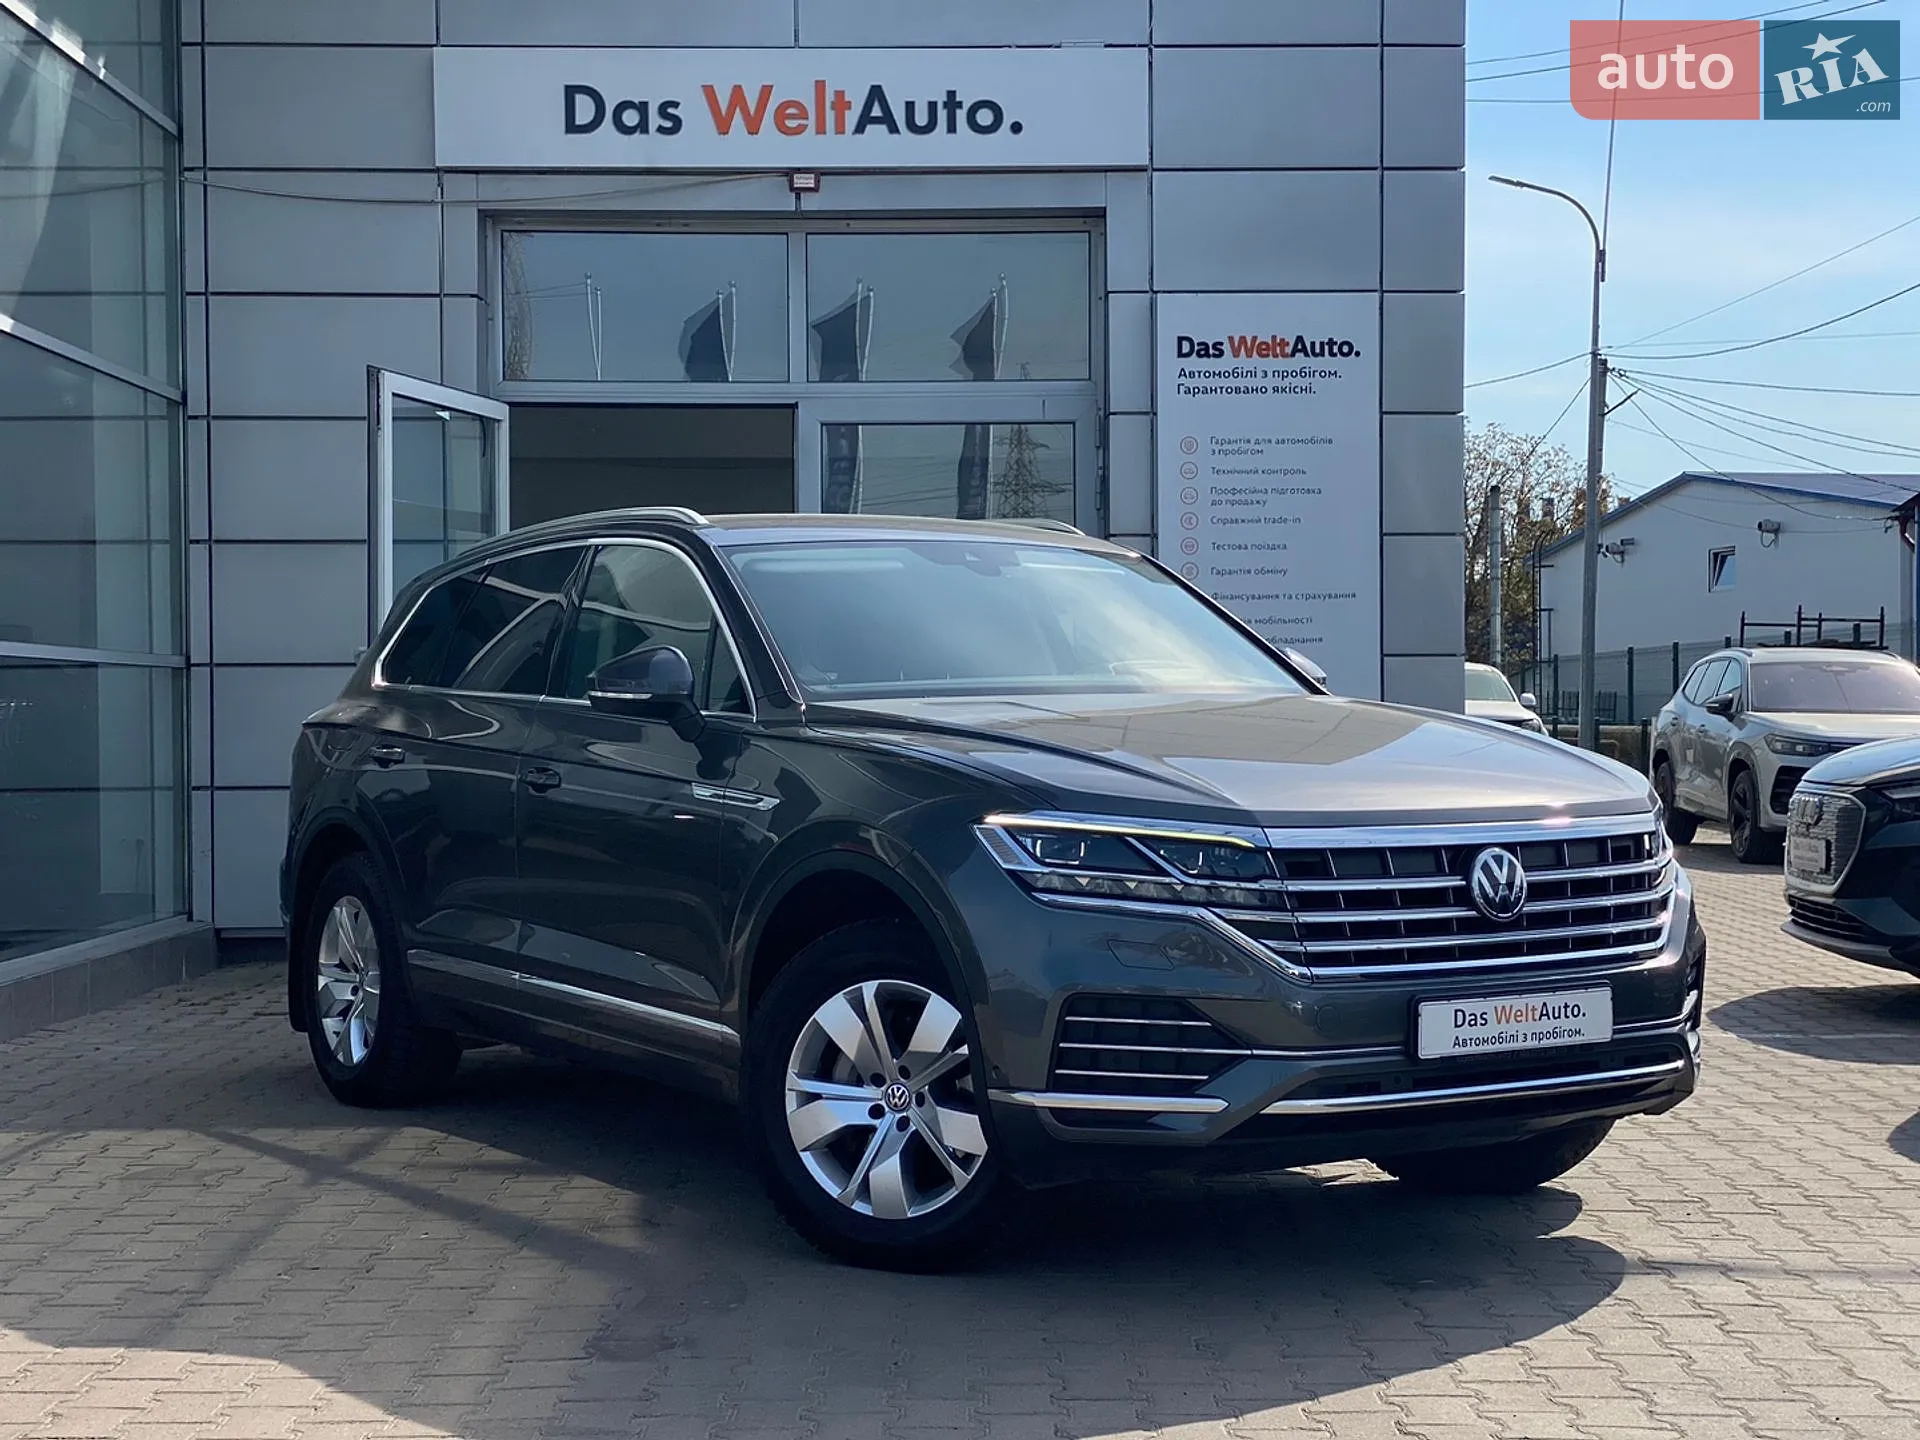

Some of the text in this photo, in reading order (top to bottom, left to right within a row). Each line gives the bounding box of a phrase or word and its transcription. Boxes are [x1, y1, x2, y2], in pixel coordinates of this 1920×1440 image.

[564, 79, 1024, 136] Das WeltAuto.
[1177, 335, 1361, 359] Das WeltAuto.
[1178, 366, 1342, 381] Автомобілі з пробігом.
[1177, 382, 1316, 397] Гарантовано якісні.
[1210, 436, 1333, 447] Гарантія для автомобілів
[1210, 446, 1264, 457] з пробігом
[1211, 466, 1307, 477] Технічний контроль
[1210, 486, 1322, 496] Професійна підготовка
[1210, 498, 1267, 508] до продажу
[1210, 515, 1302, 525] Справжній trade-in
[1211, 542, 1248, 551] Тестова
[1210, 566, 1288, 577] Гарантія обміну
[1211, 591, 1356, 602] Фінансування та страхування
[1254, 615, 1313, 625] мобільності
[1453, 1001, 1586, 1029] Das WeltAuto.
[1452, 1026, 1585, 1048] Автомобілі з пробігом.
